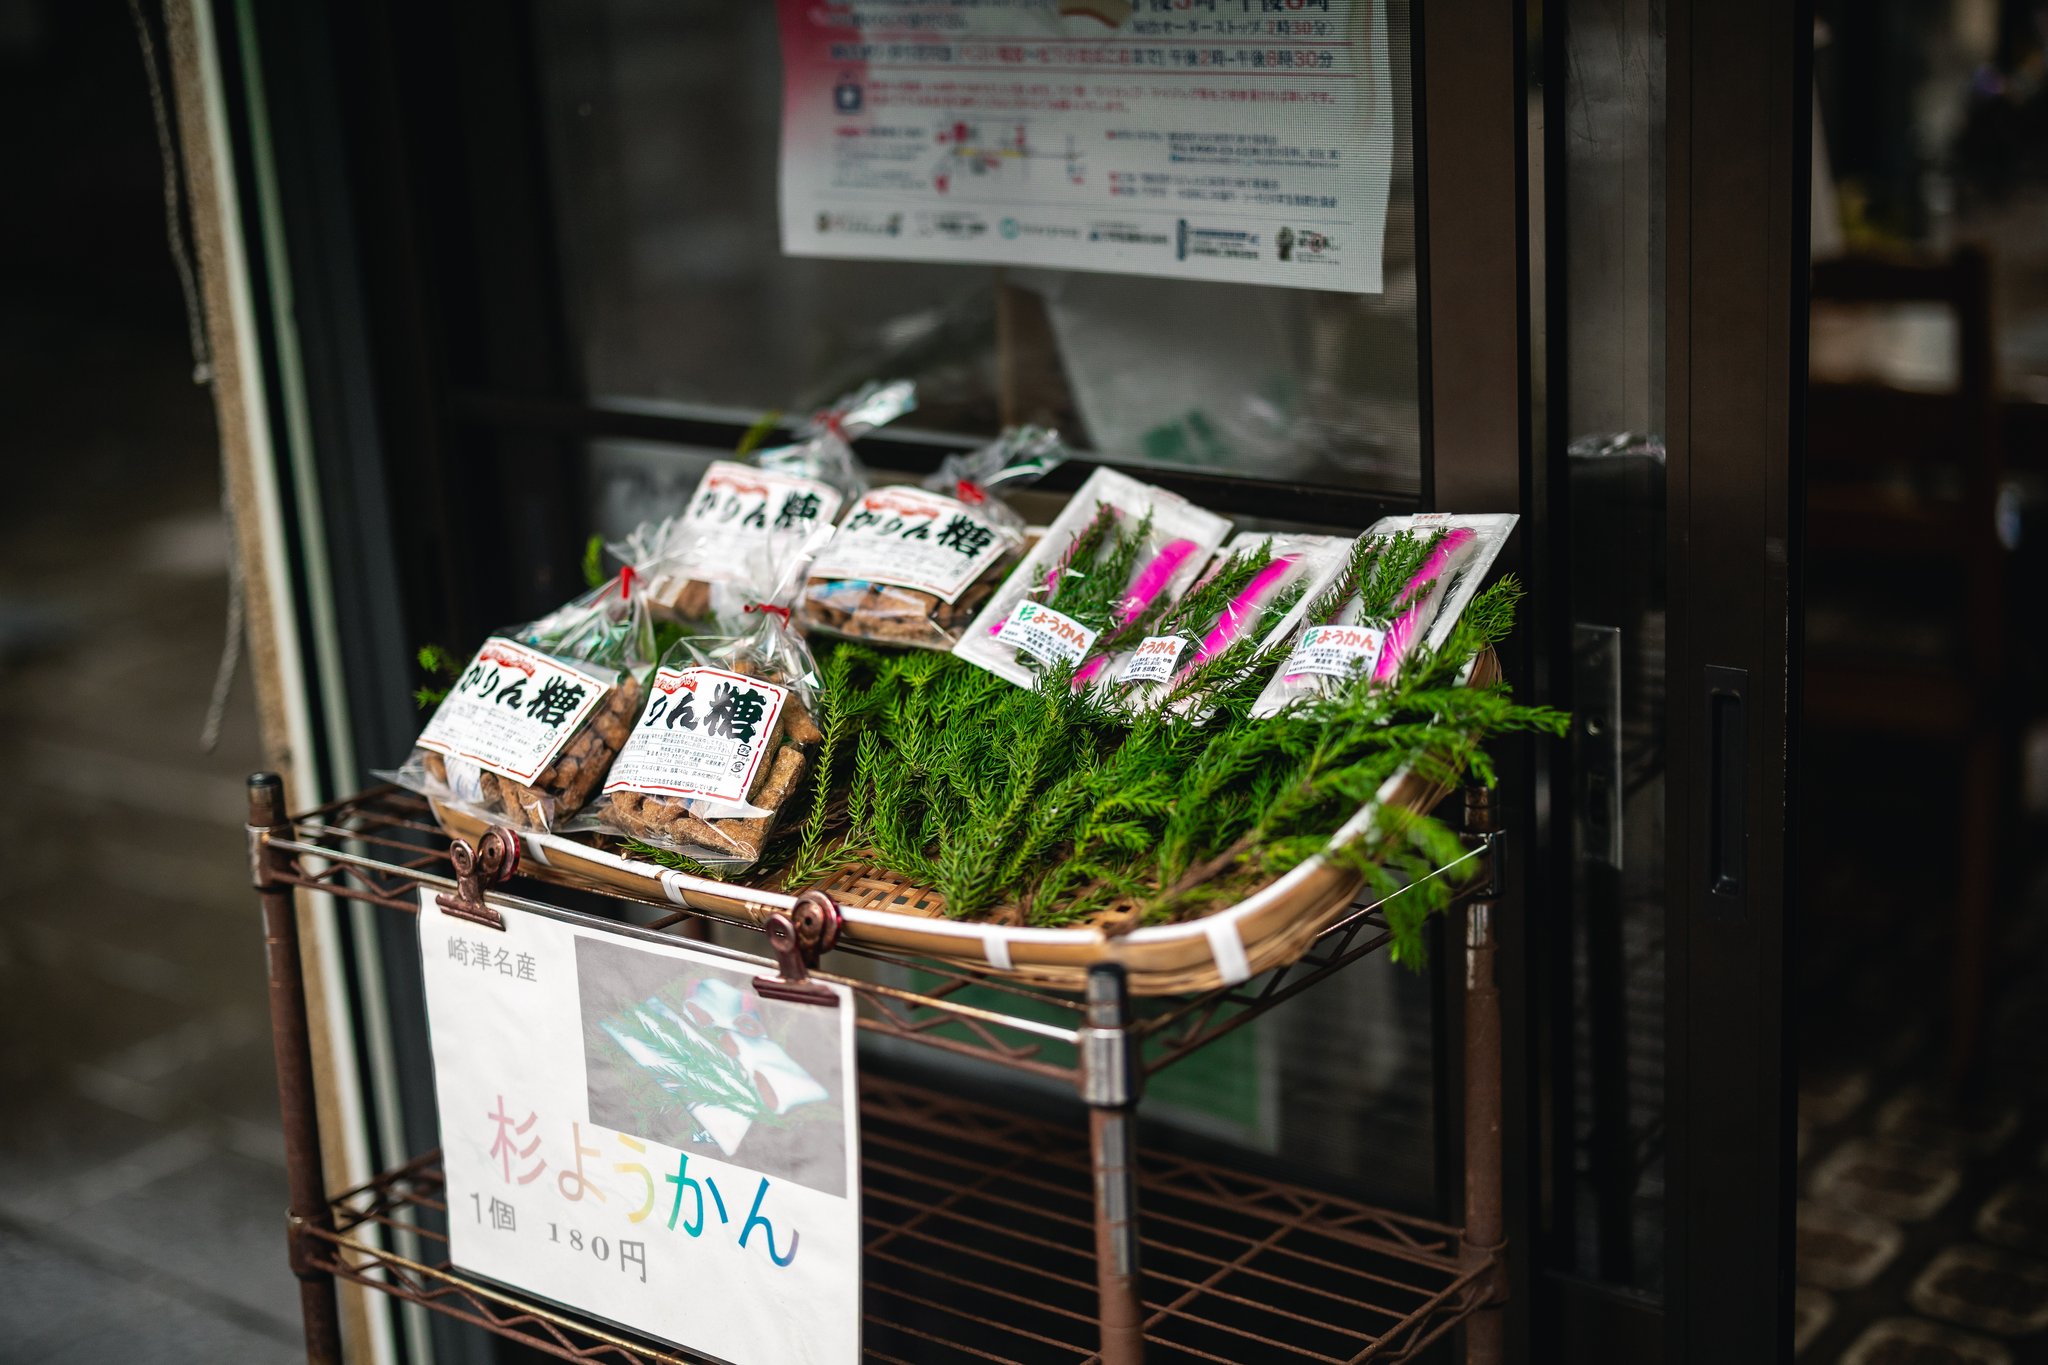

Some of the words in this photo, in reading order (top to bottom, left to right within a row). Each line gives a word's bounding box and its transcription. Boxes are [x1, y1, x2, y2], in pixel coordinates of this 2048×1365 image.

[847, 511, 996, 558] かりん糖
[1018, 604, 1086, 649] 杉ようかん
[1303, 629, 1375, 651] 杉ようかん
[459, 665, 586, 728] かりん糖
[447, 936, 537, 982] 崎津名産
[488, 1094, 799, 1267] 杉ようかん
[470, 1192, 516, 1232] 1個
[548, 1223, 647, 1284] 180円
